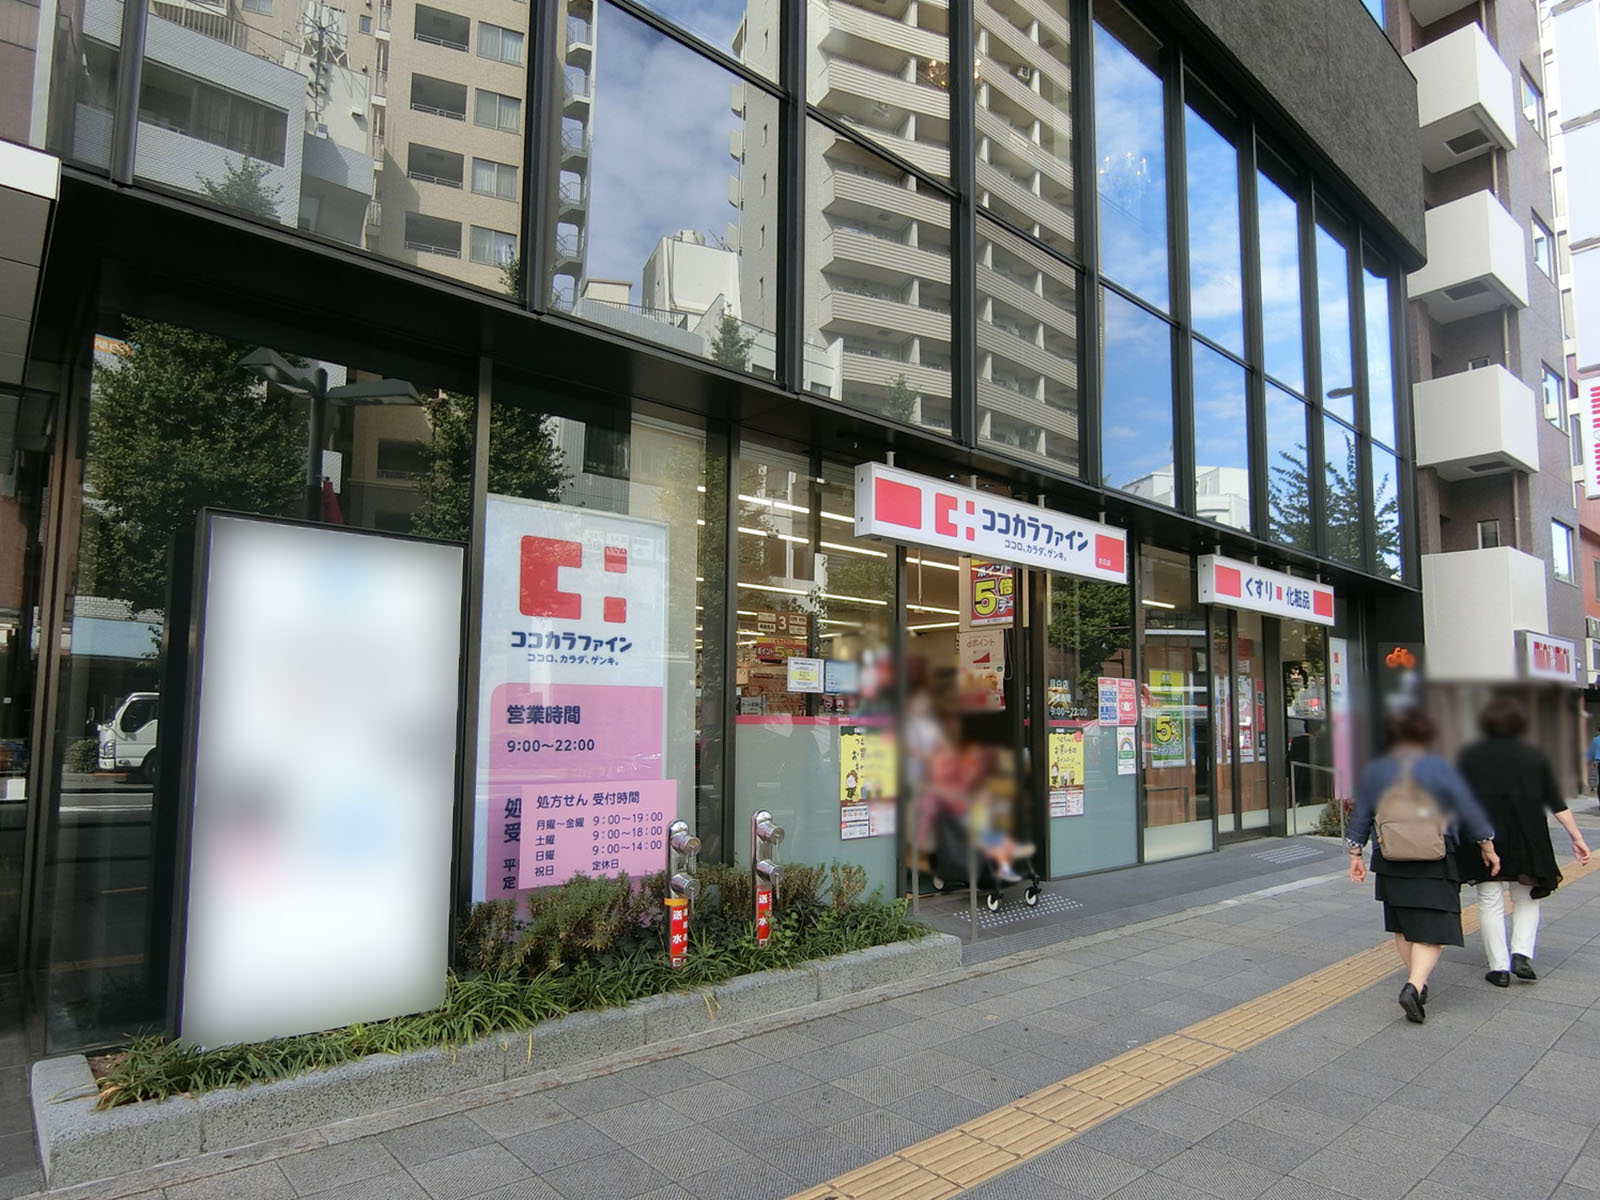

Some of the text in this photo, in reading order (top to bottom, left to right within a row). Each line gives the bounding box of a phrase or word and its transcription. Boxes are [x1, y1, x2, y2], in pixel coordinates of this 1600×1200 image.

[982, 508, 1089, 552] ココカラファイン
[1245, 577, 1311, 610] くすり 化粧品
[778, 615, 787, 630] 3
[510, 630, 633, 654] ココカラファイン
[526, 653, 620, 667] ココロ、カラダ、ゲンキ。
[506, 704, 582, 725] 営業時間
[506, 738, 596, 753] 9:00～22:00
[536, 790, 641, 810] 処方せん 受付時間
[535, 816, 585, 832] 月曜～金曜
[535, 833, 556, 846] 土曜
[535, 850, 556, 862] 日曜
[534, 859, 620, 877] 祝日 定休日
[672, 910, 683, 967] 送水口
